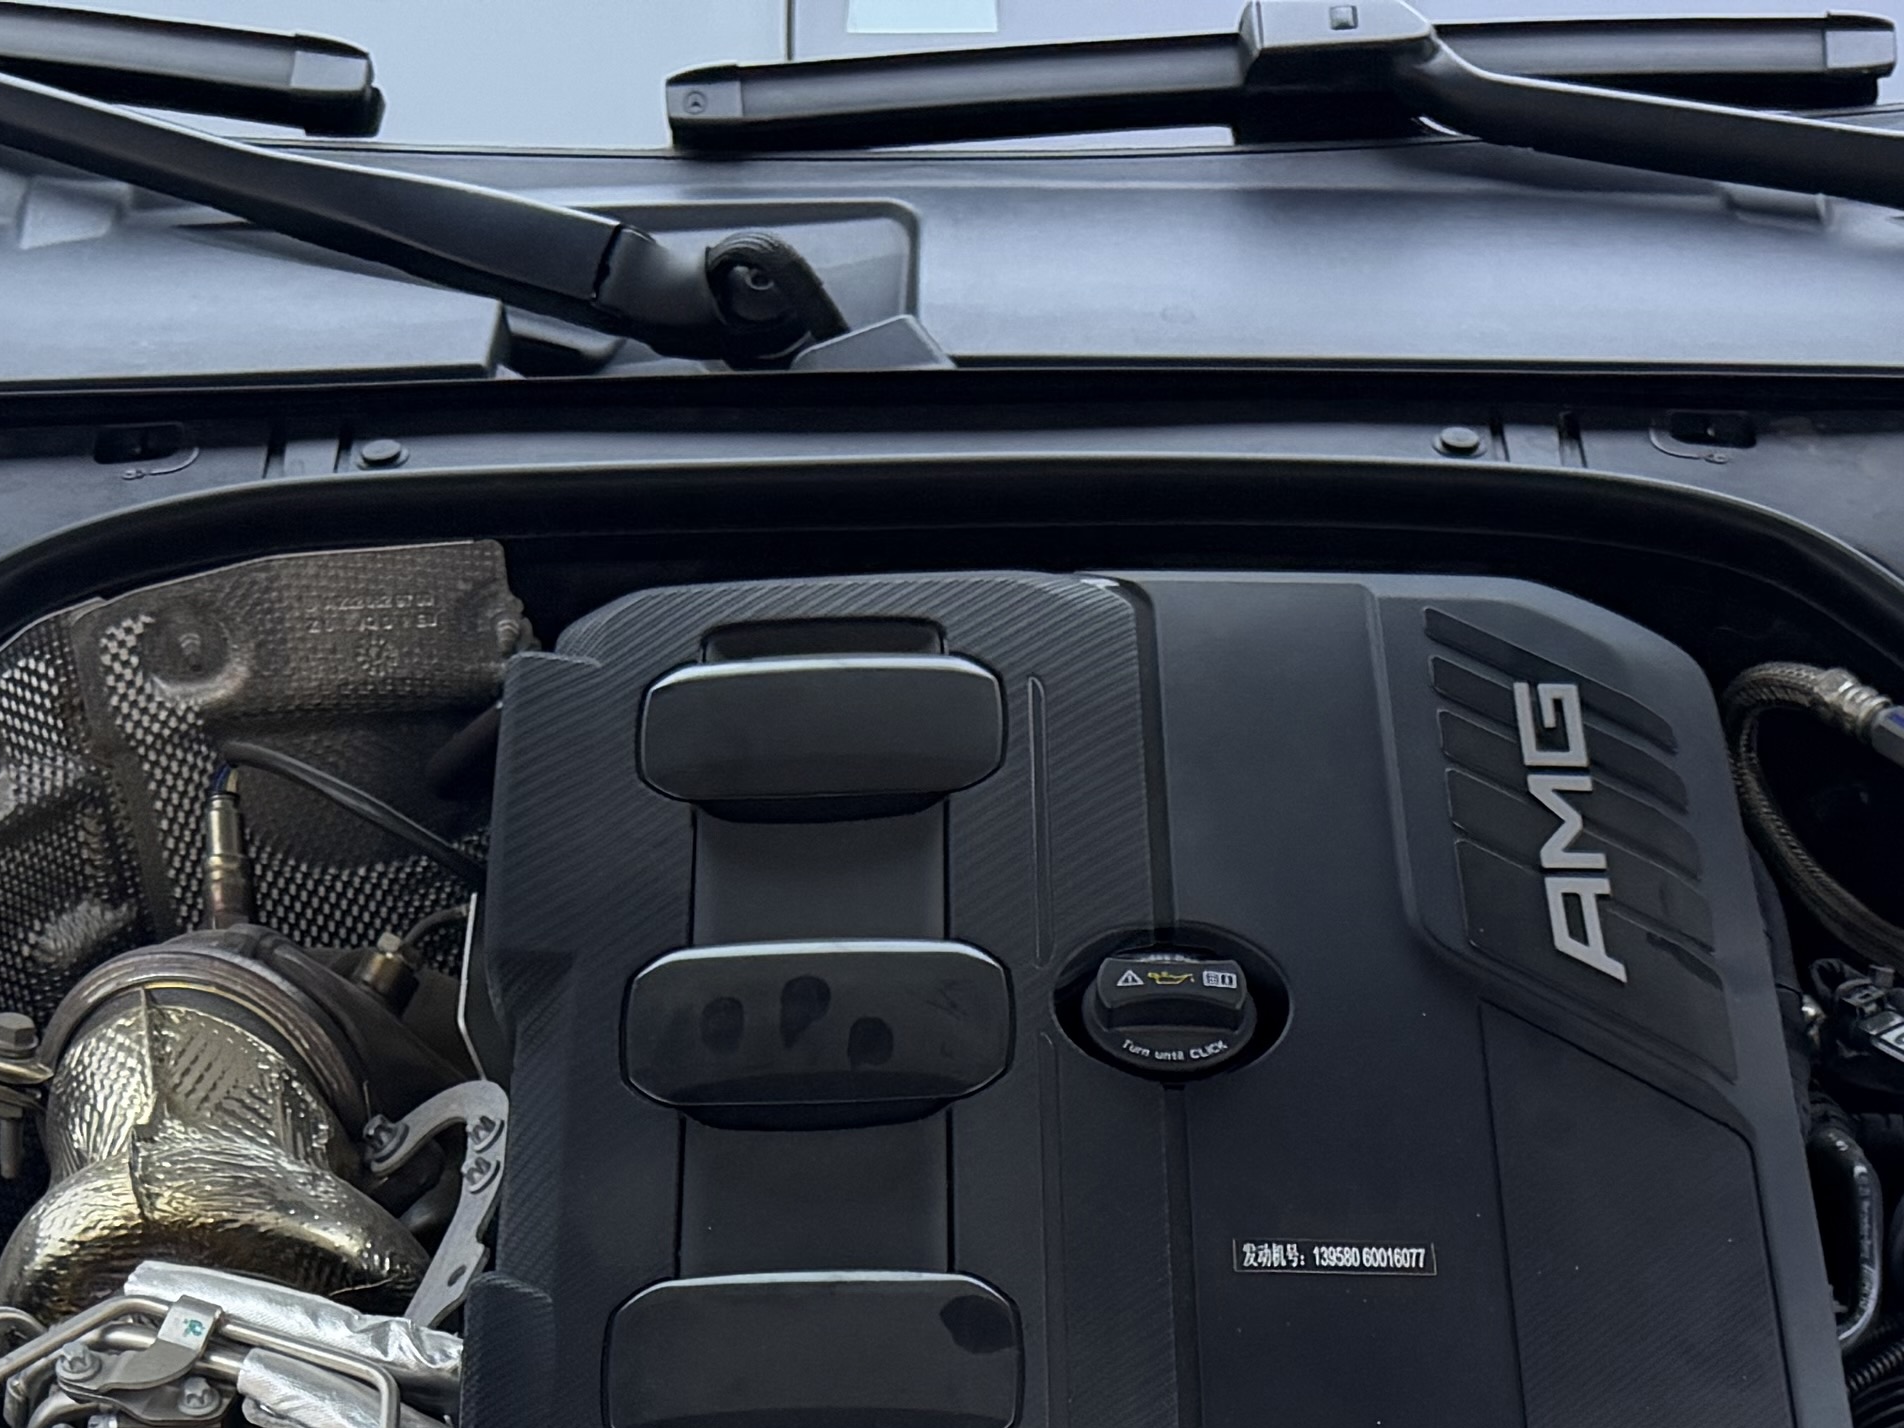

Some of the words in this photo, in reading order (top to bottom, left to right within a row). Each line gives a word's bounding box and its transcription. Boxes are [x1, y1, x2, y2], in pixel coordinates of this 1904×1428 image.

[1513, 681, 1627, 983] AMG
[1122, 1039, 1150, 1058] Turn
[1154, 1050, 1185, 1061] until
[1190, 1040, 1229, 1059] CLICK
[1312, 1246, 1360, 1267] 139580
[1362, 1247, 1426, 1268] 60016077
